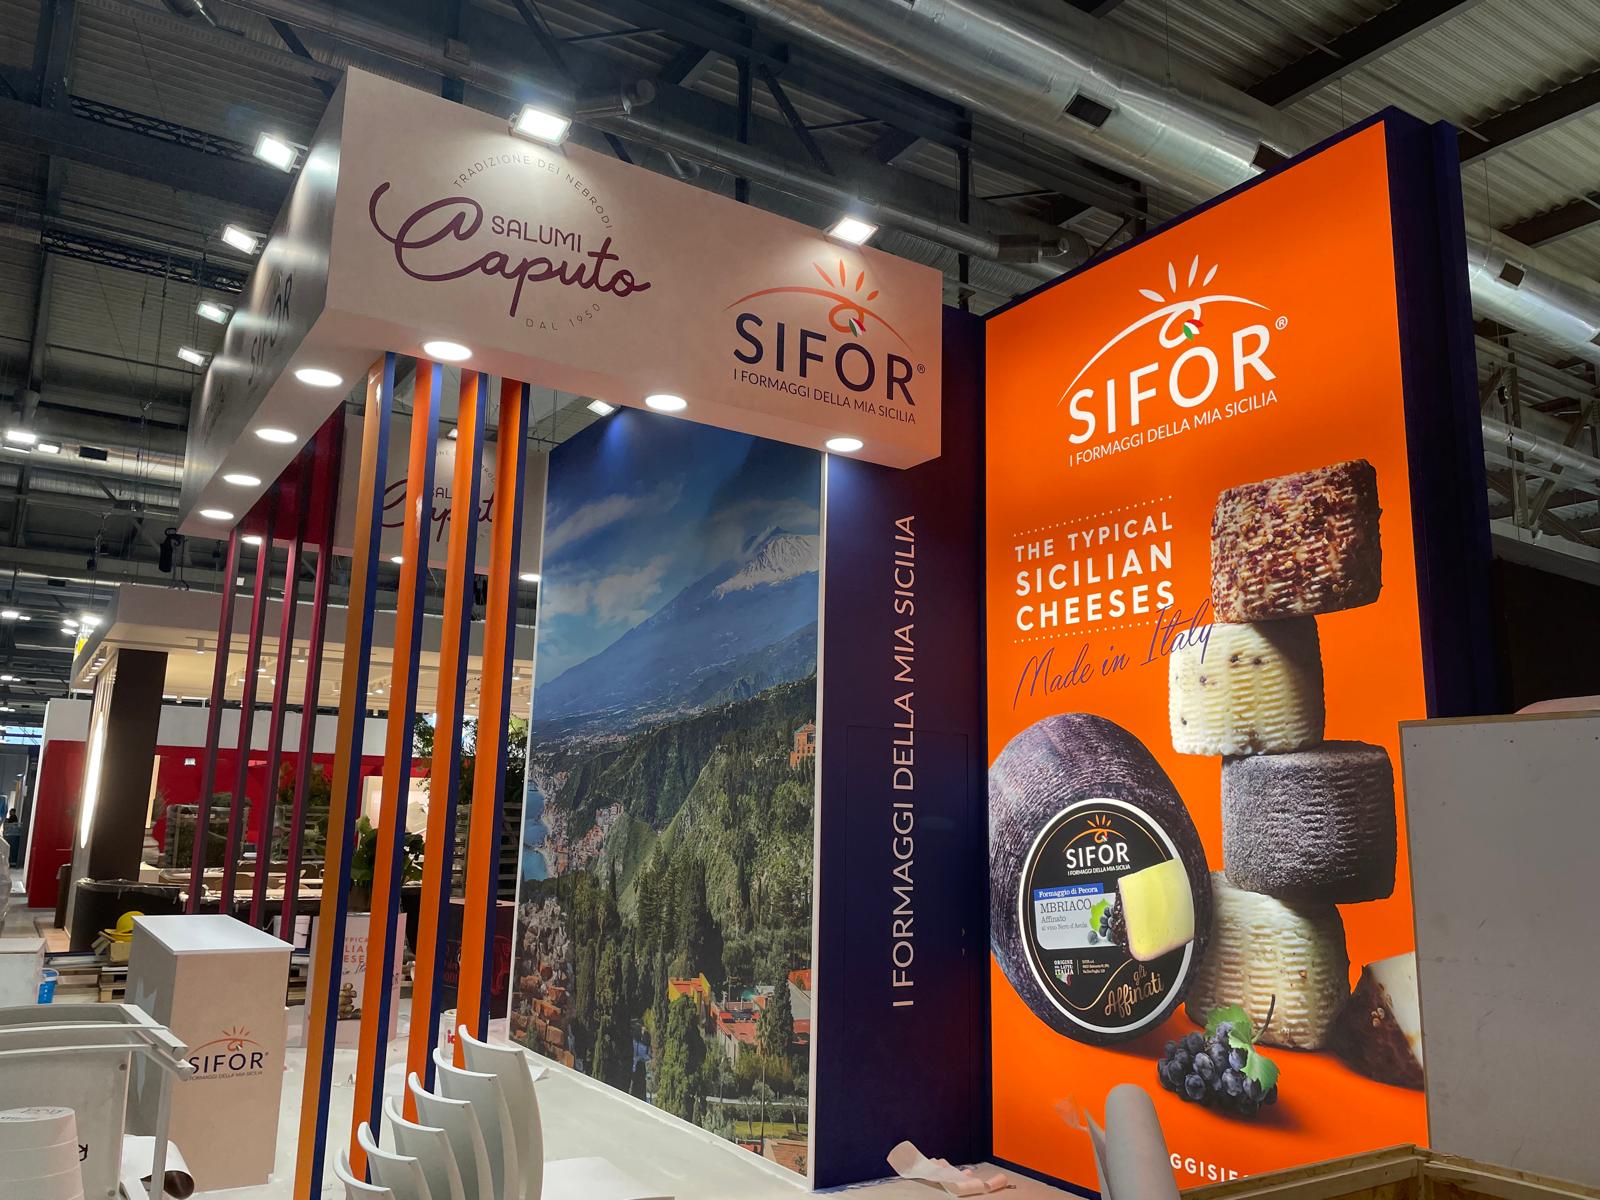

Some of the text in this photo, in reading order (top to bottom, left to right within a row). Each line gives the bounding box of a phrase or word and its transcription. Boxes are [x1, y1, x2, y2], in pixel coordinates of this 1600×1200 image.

[453, 154, 613, 229] TRADIZIONE DEI NEBRODI
[369, 181, 651, 317] Caputo
[491, 215, 582, 253] SALUMI
[525, 303, 601, 331] DAL 1950
[733, 368, 916, 425] I FORMAGGI DELLA MIA SICILIA
[1069, 389, 1278, 467] I FORMAGGI DELLA MIA SICILIA
[1014, 511, 1173, 563] THE TYPICAL
[894, 515, 915, 616] SICILIA
[1015, 541, 1172, 597] SICILIAN
[1016, 580, 1175, 631] CHEESES
[894, 623, 915, 683] MIA
[1012, 598, 1214, 711] Made in Italy
[893, 692, 914, 790] DELLA
[1065, 842, 1130, 869] SIFOR
[1070, 868, 1093, 876] FORMAGGI
[1093, 866, 1107, 874] DELLA
[892, 803, 914, 987] FORMAGGI
[1039, 889, 1070, 898] Formaggio
[1078, 886, 1099, 894] Pecora
[1040, 898, 1092, 914] MBRIACO
[1041, 915, 1067, 924] Affinato
[1104, 973, 1165, 1019] Affinati
[1133, 964, 1147, 987] gli
